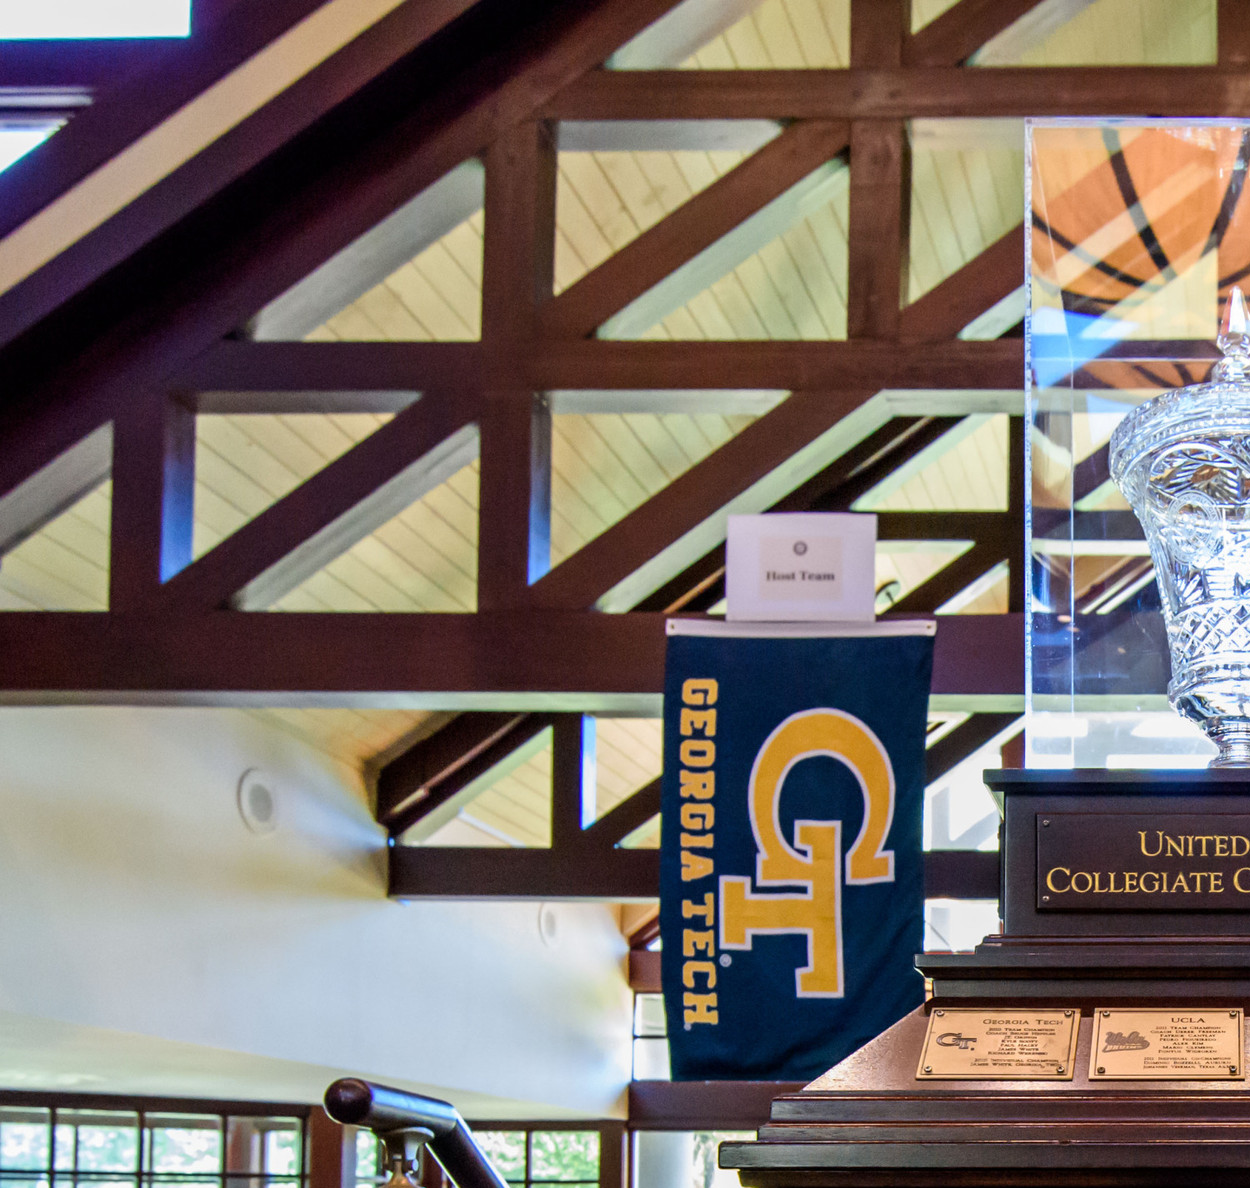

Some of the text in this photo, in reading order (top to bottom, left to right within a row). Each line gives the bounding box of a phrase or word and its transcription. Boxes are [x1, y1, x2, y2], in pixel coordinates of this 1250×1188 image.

[766, 571, 835, 581] Host Team
[679, 678, 719, 1026] GEORGIA TECH
[1138, 831, 1250, 858] UNITED
[1046, 866, 1225, 894] COLLEGIATE
